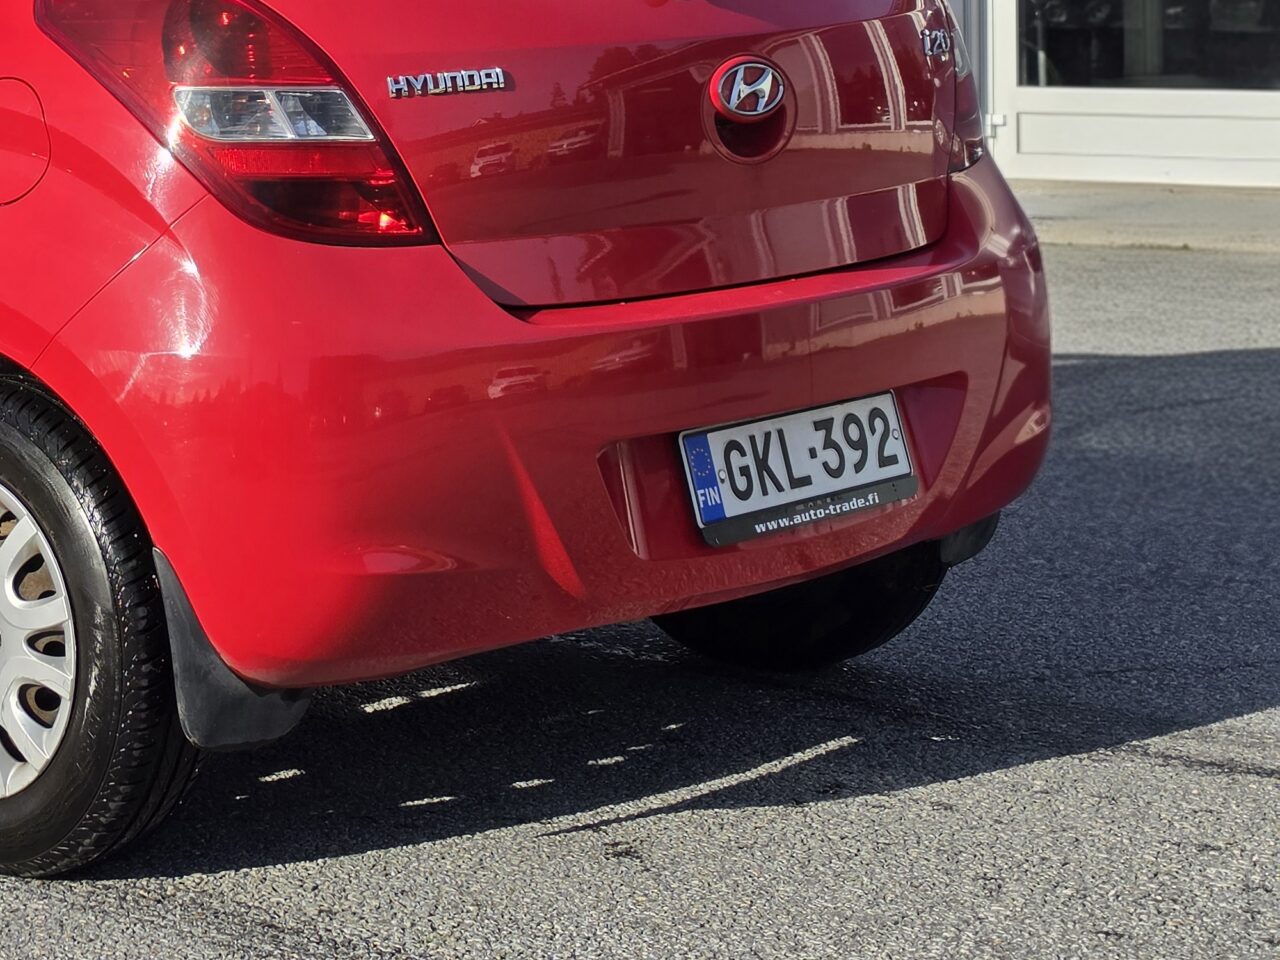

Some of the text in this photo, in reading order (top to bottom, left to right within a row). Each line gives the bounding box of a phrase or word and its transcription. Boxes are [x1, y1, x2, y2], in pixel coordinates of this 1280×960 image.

[386, 66, 506, 99] HYUNDAI
[698, 406, 900, 509] FIN GKL-392
[754, 492, 880, 534] www.auto-trade.fi
